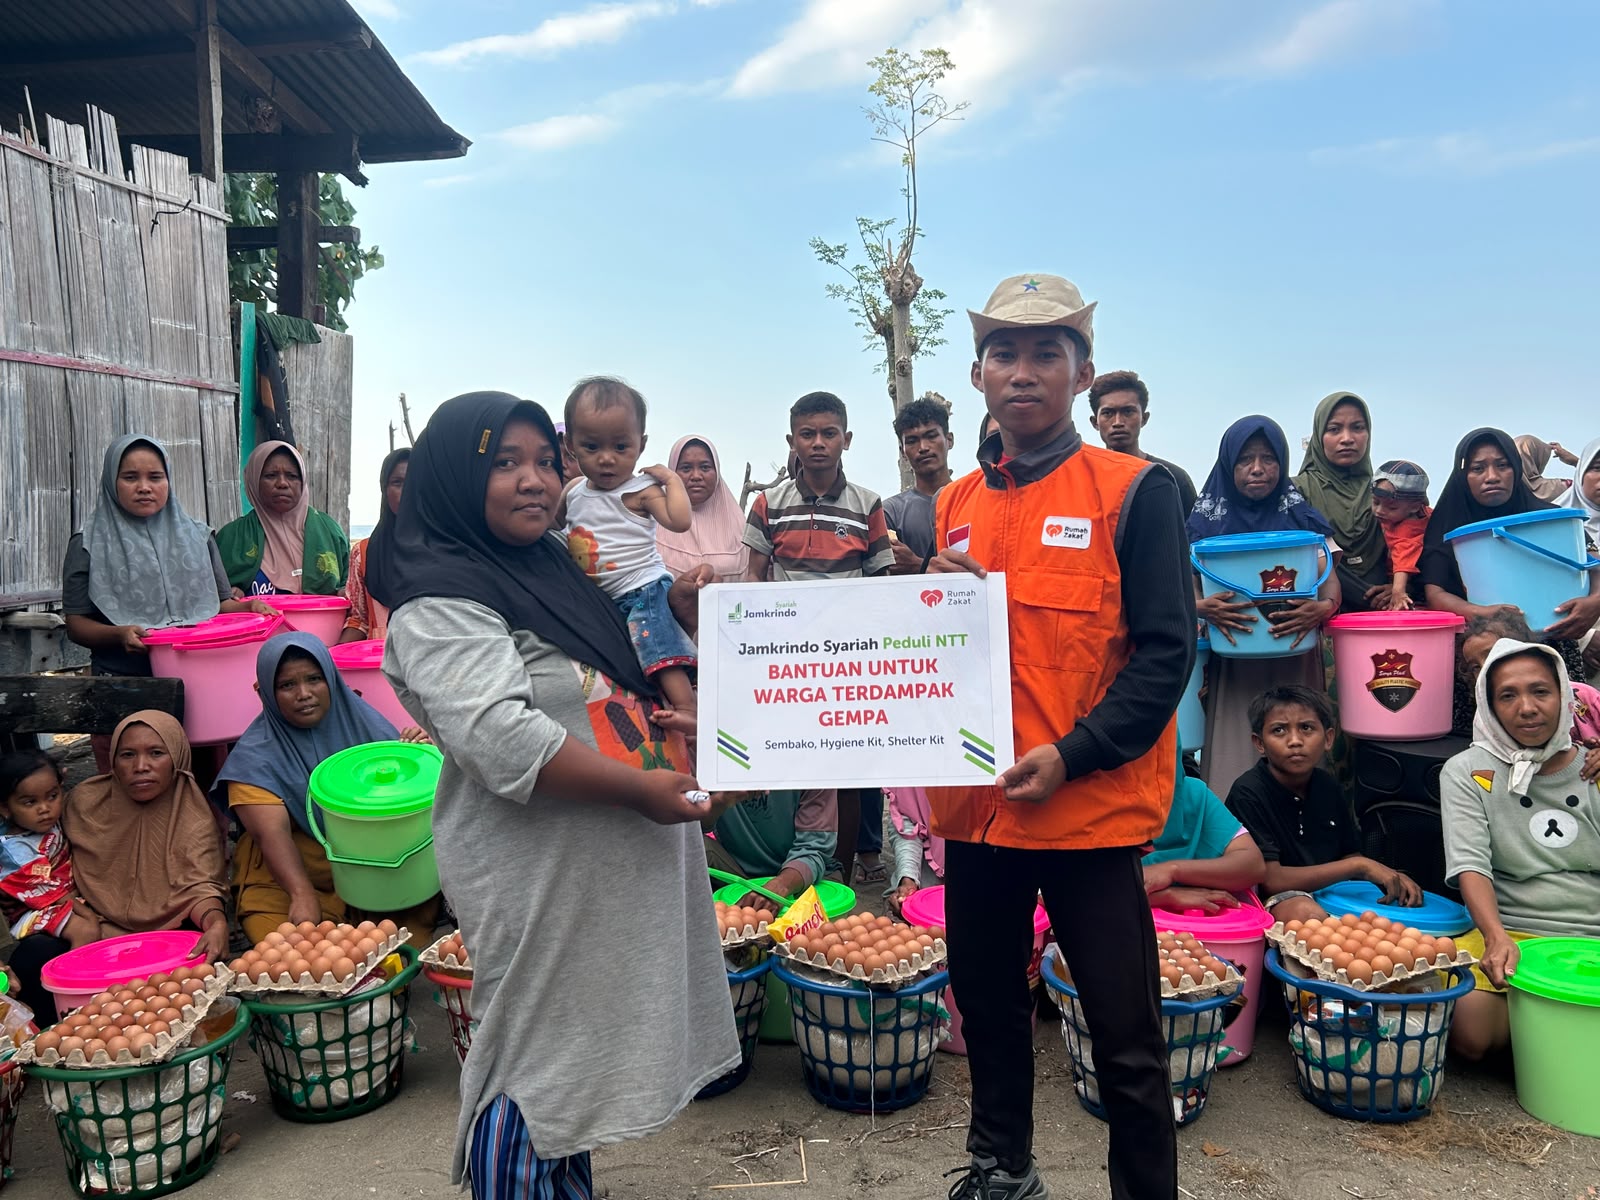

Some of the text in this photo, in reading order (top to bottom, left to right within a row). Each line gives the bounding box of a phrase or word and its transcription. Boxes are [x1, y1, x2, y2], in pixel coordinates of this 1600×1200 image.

[1064, 526, 1088, 534] Rumah
[947, 589, 976, 598] Rumah
[775, 601, 797, 609] Syariah
[947, 598, 971, 606] Zakat
[743, 608, 797, 618] Jamkrindo
[738, 633, 969, 656] Jamkrindo Syariah Peduli NTT
[768, 657, 938, 680] BANTUAN UNTUK
[753, 682, 954, 704] WARGA TERDAMPAK
[818, 708, 889, 727] GEMPA
[764, 734, 945, 751] Sembako, Hygiene Kit, Shelter Kit
